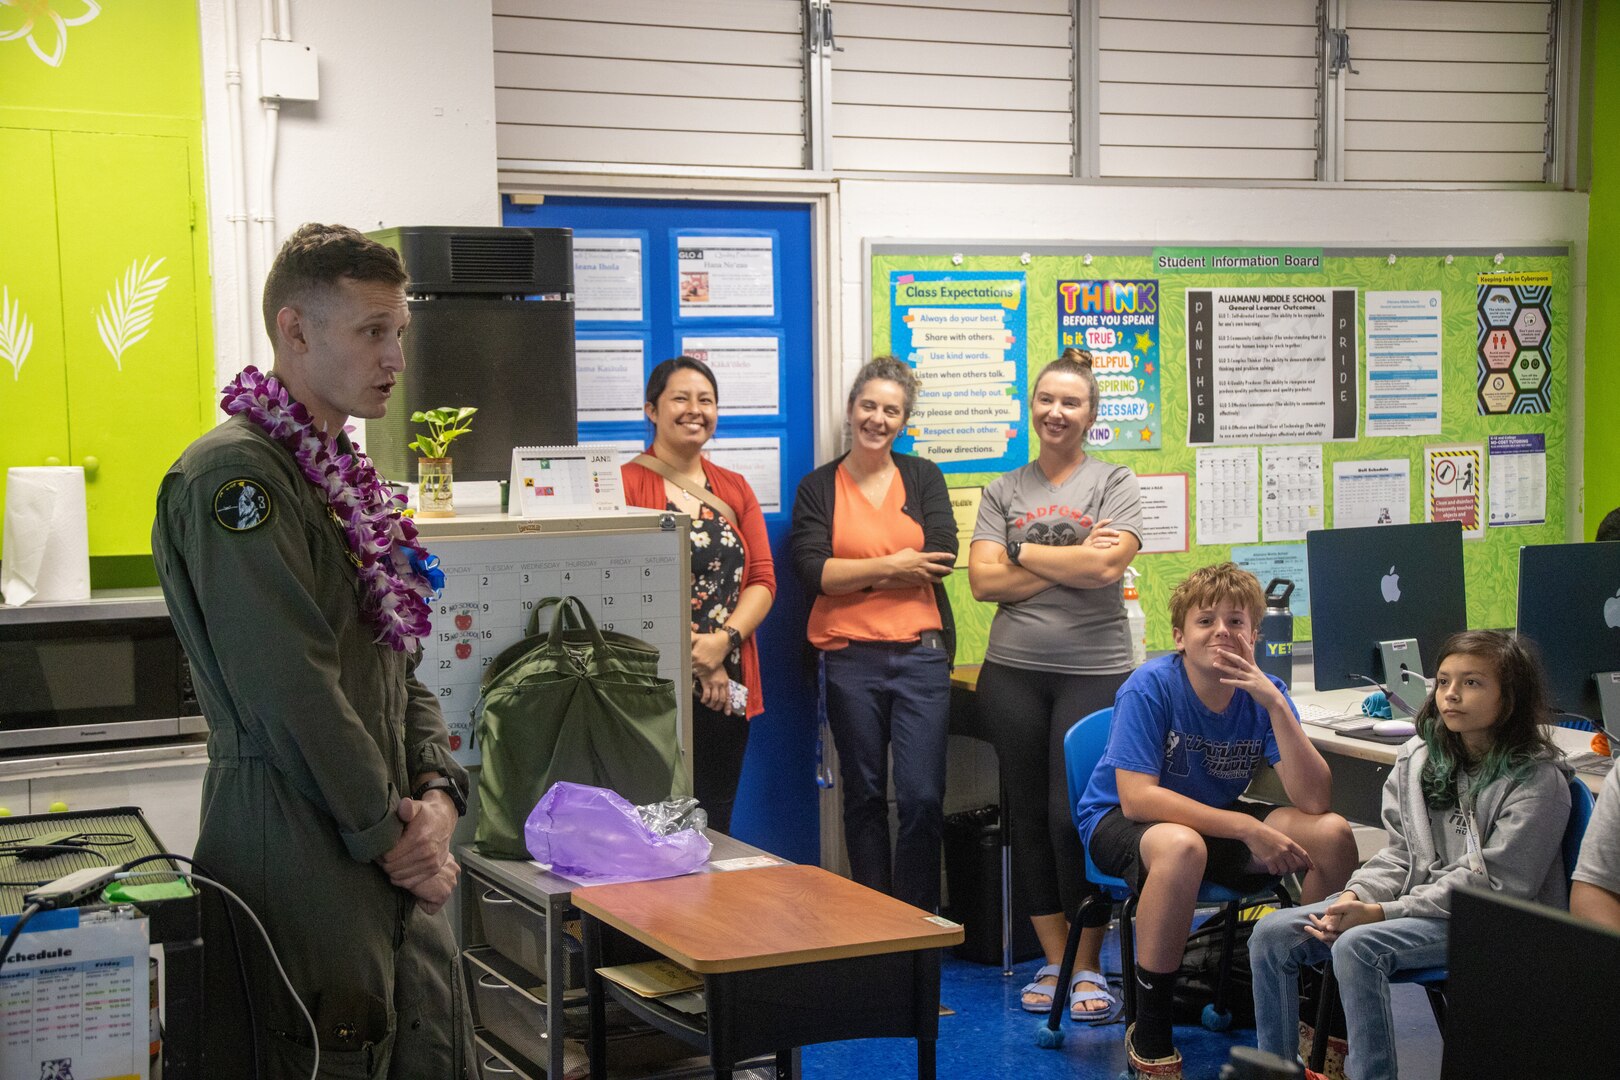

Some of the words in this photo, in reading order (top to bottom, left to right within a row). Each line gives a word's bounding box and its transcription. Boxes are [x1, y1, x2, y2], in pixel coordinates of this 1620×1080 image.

[1158, 256, 1205, 268] Student
[1212, 255, 1279, 267] Information
[1284, 255, 1319, 267] Board
[906, 286, 937, 297] Class
[941, 286, 1013, 300] Expectations
[1060, 282, 1156, 314] THINK
[1218, 295, 1261, 303] ALIAMANU
[920, 314, 947, 323] Always
[1063, 315, 1098, 326] BEFORE
[1100, 315, 1120, 325] YOU
[1122, 315, 1154, 325] SPEAK!
[1063, 332, 1073, 345] Is
[1075, 332, 1083, 345] it
[1088, 332, 1112, 344] TRUE
[1117, 332, 1123, 344] ?
[1134, 356, 1139, 367] ?
[1098, 380, 1134, 392] SPIRING
[1139, 379, 1144, 391] ?
[971, 389, 987, 398] help
[911, 409, 925, 417] Say
[1098, 403, 1144, 416] CESSARY
[1149, 403, 1154, 414] ?
[924, 427, 954, 436] Respect
[1090, 429, 1110, 440] KIND
[1114, 427, 1120, 440] ?
[258, 496, 265, 508] 3
[1015, 505, 1093, 528] RADFORD
[483, 577, 488, 585] 2
[644, 568, 650, 576] 6
[440, 606, 446, 614] 8
[483, 604, 488, 612] 9
[604, 597, 613, 605] 12
[481, 631, 492, 639] 16
[643, 621, 653, 629] 20
[1268, 643, 1292, 655] YET
[440, 660, 451, 668] 22
[440, 688, 451, 696] 29
[4, 948, 72, 963] chedule
[40, 966, 76, 974] Thursday
